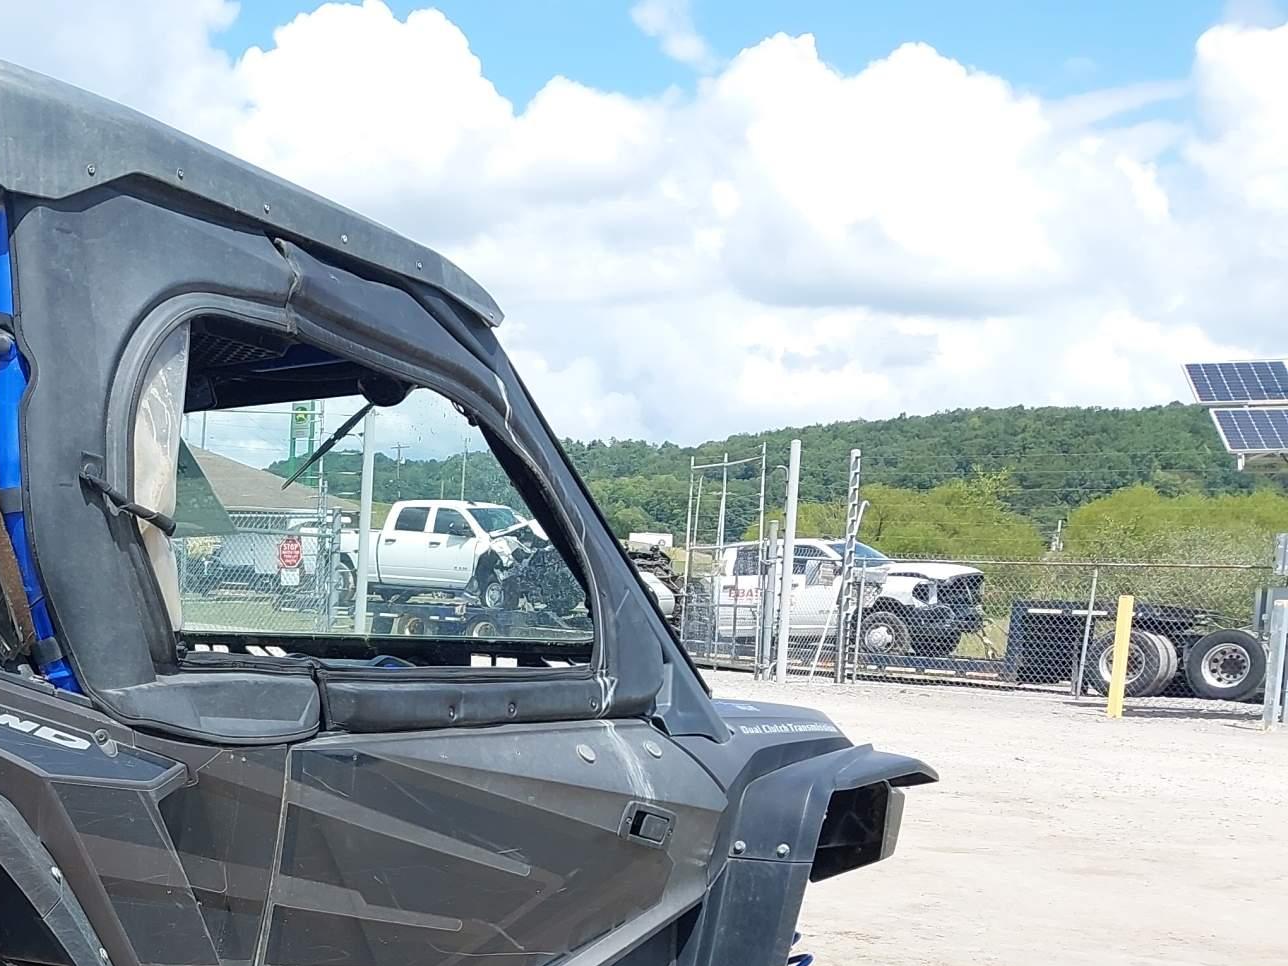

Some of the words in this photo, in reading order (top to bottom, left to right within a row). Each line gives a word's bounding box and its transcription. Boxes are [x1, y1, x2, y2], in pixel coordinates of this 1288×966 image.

[283, 543, 299, 551] STOP
[740, 725, 762, 734] Dual
[762, 724, 789, 734] Clutch
